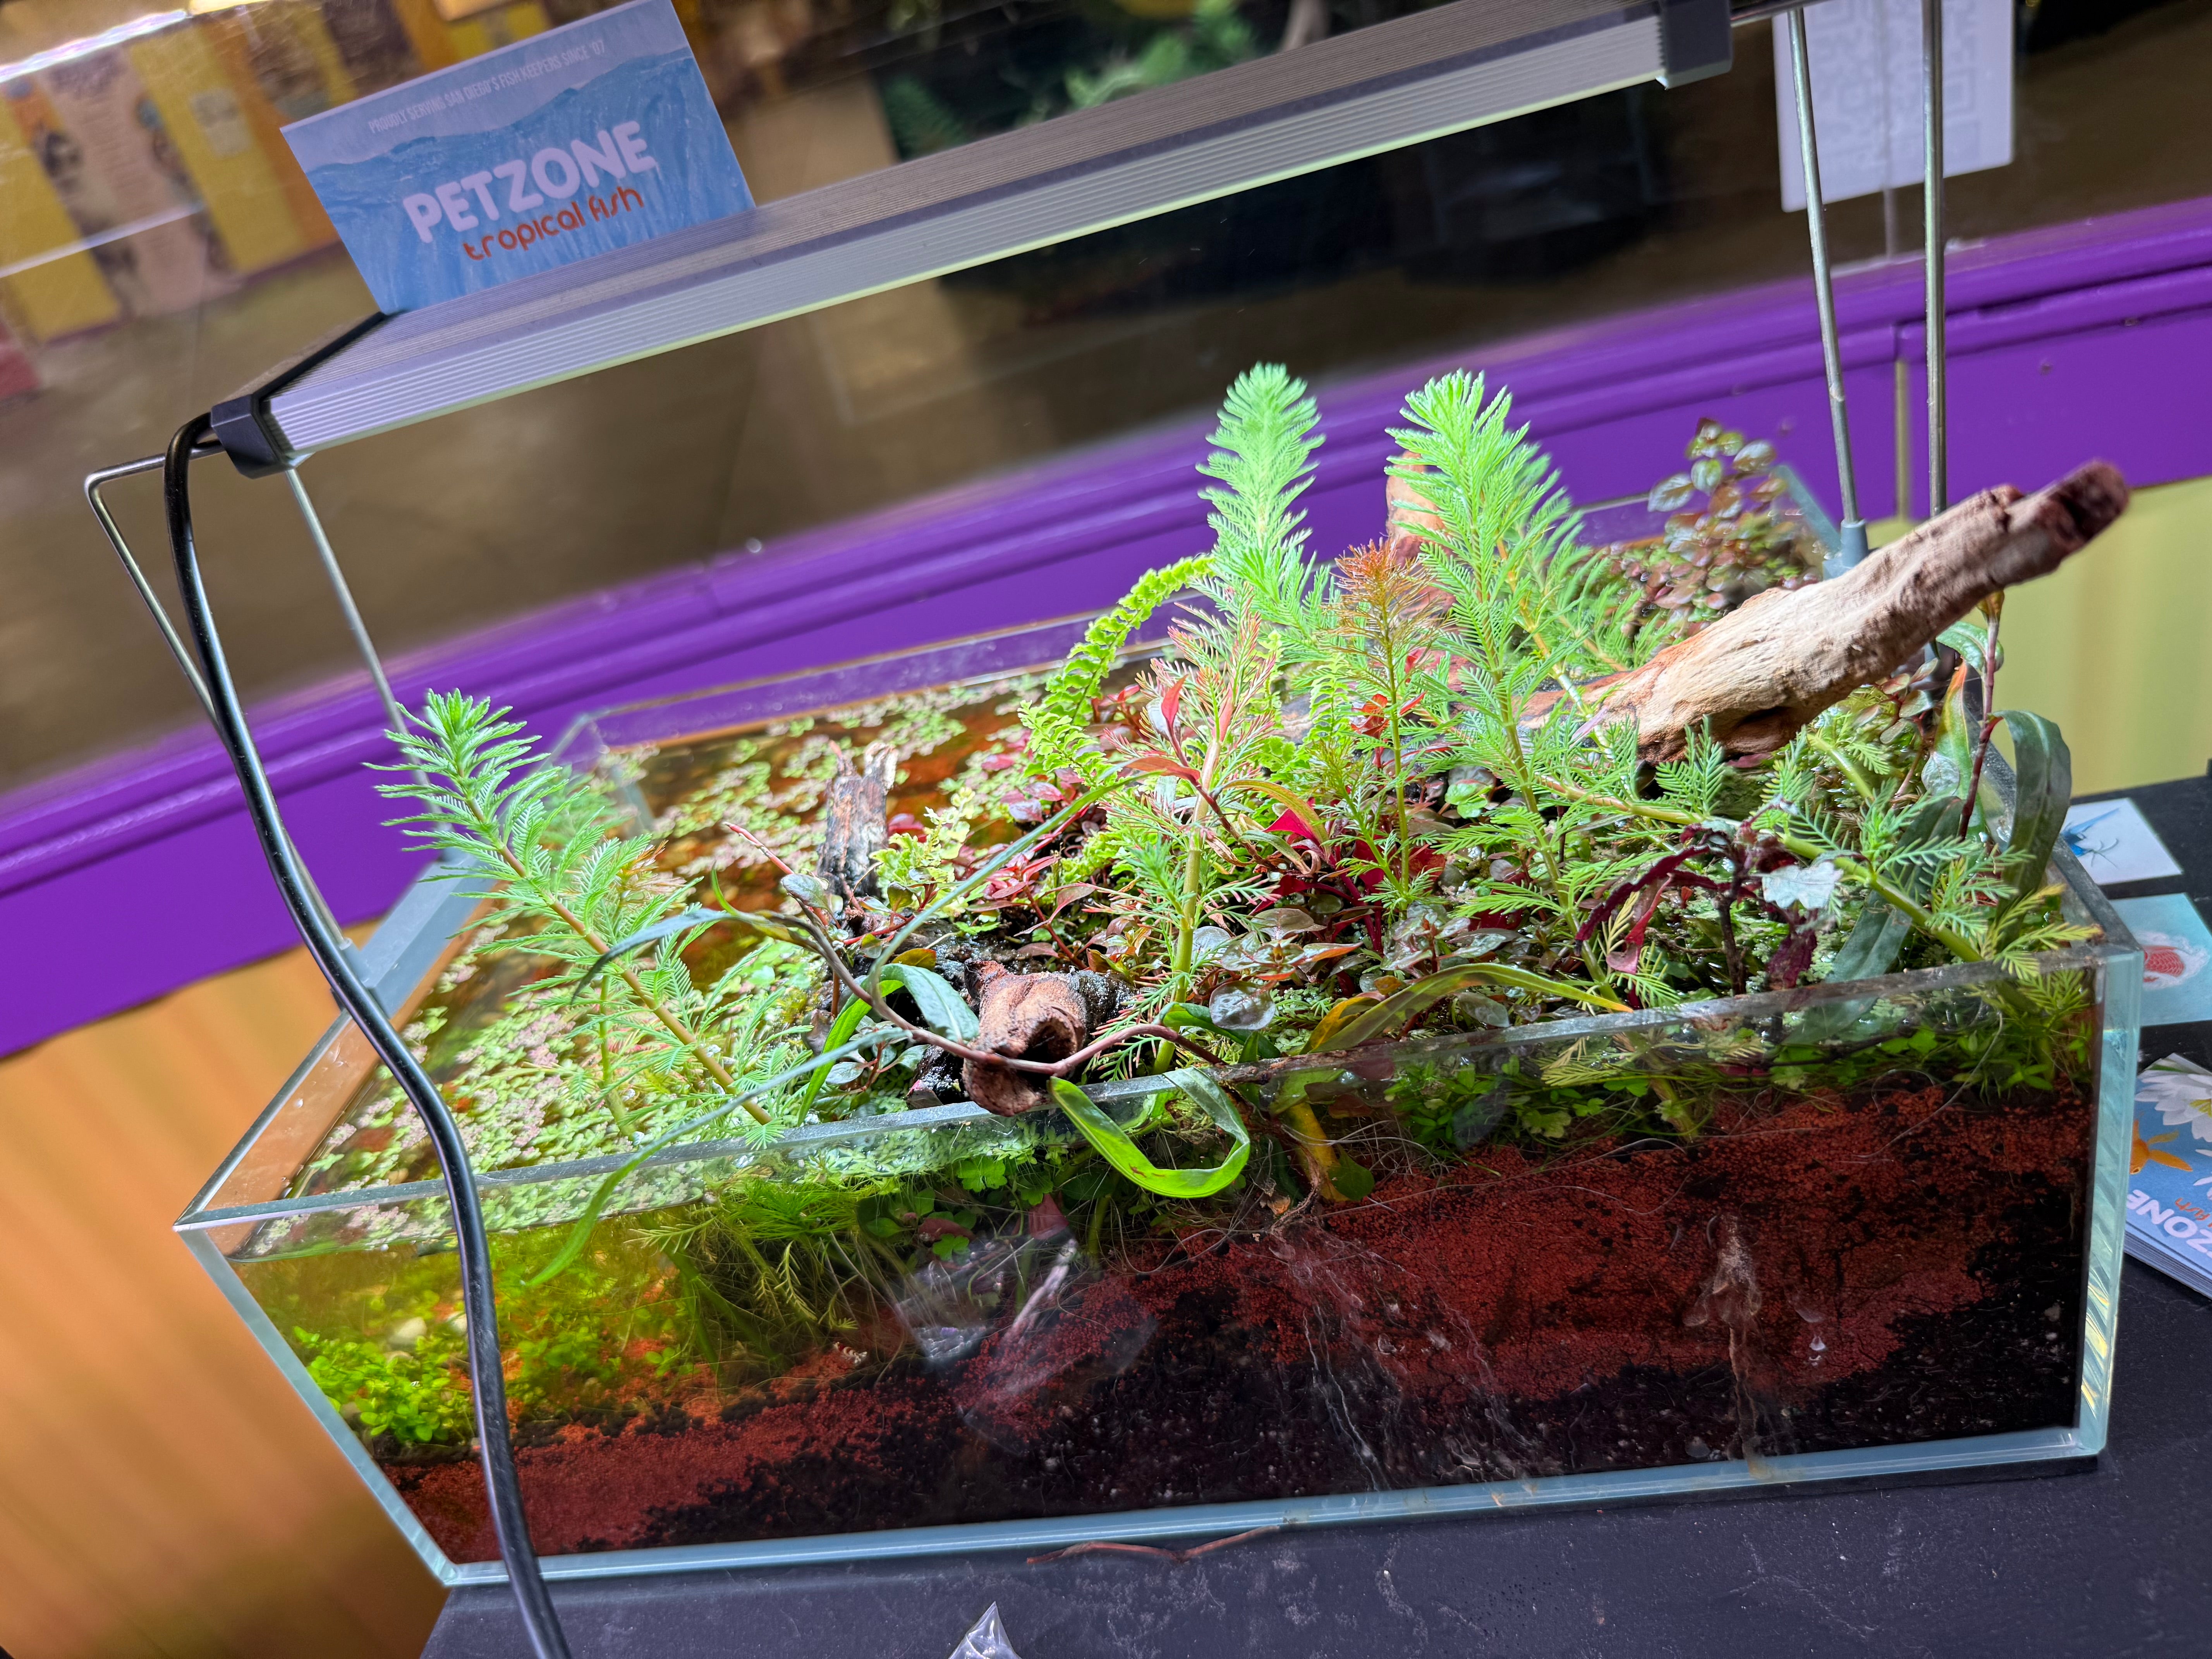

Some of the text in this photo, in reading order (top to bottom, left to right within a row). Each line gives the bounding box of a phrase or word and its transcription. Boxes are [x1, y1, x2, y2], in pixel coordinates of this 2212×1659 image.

[368, 110, 407, 134] PROUDLY
[407, 96, 446, 120] SERVING
[445, 89, 465, 107] SAN
[498, 70, 522, 88] FISH
[520, 55, 562, 80] KEEPERS
[561, 45, 590, 66] SINCE
[403, 121, 656, 243] PETZONE
[463, 186, 644, 260] tropical fish
[2126, 1189, 2212, 1259] ZONE
